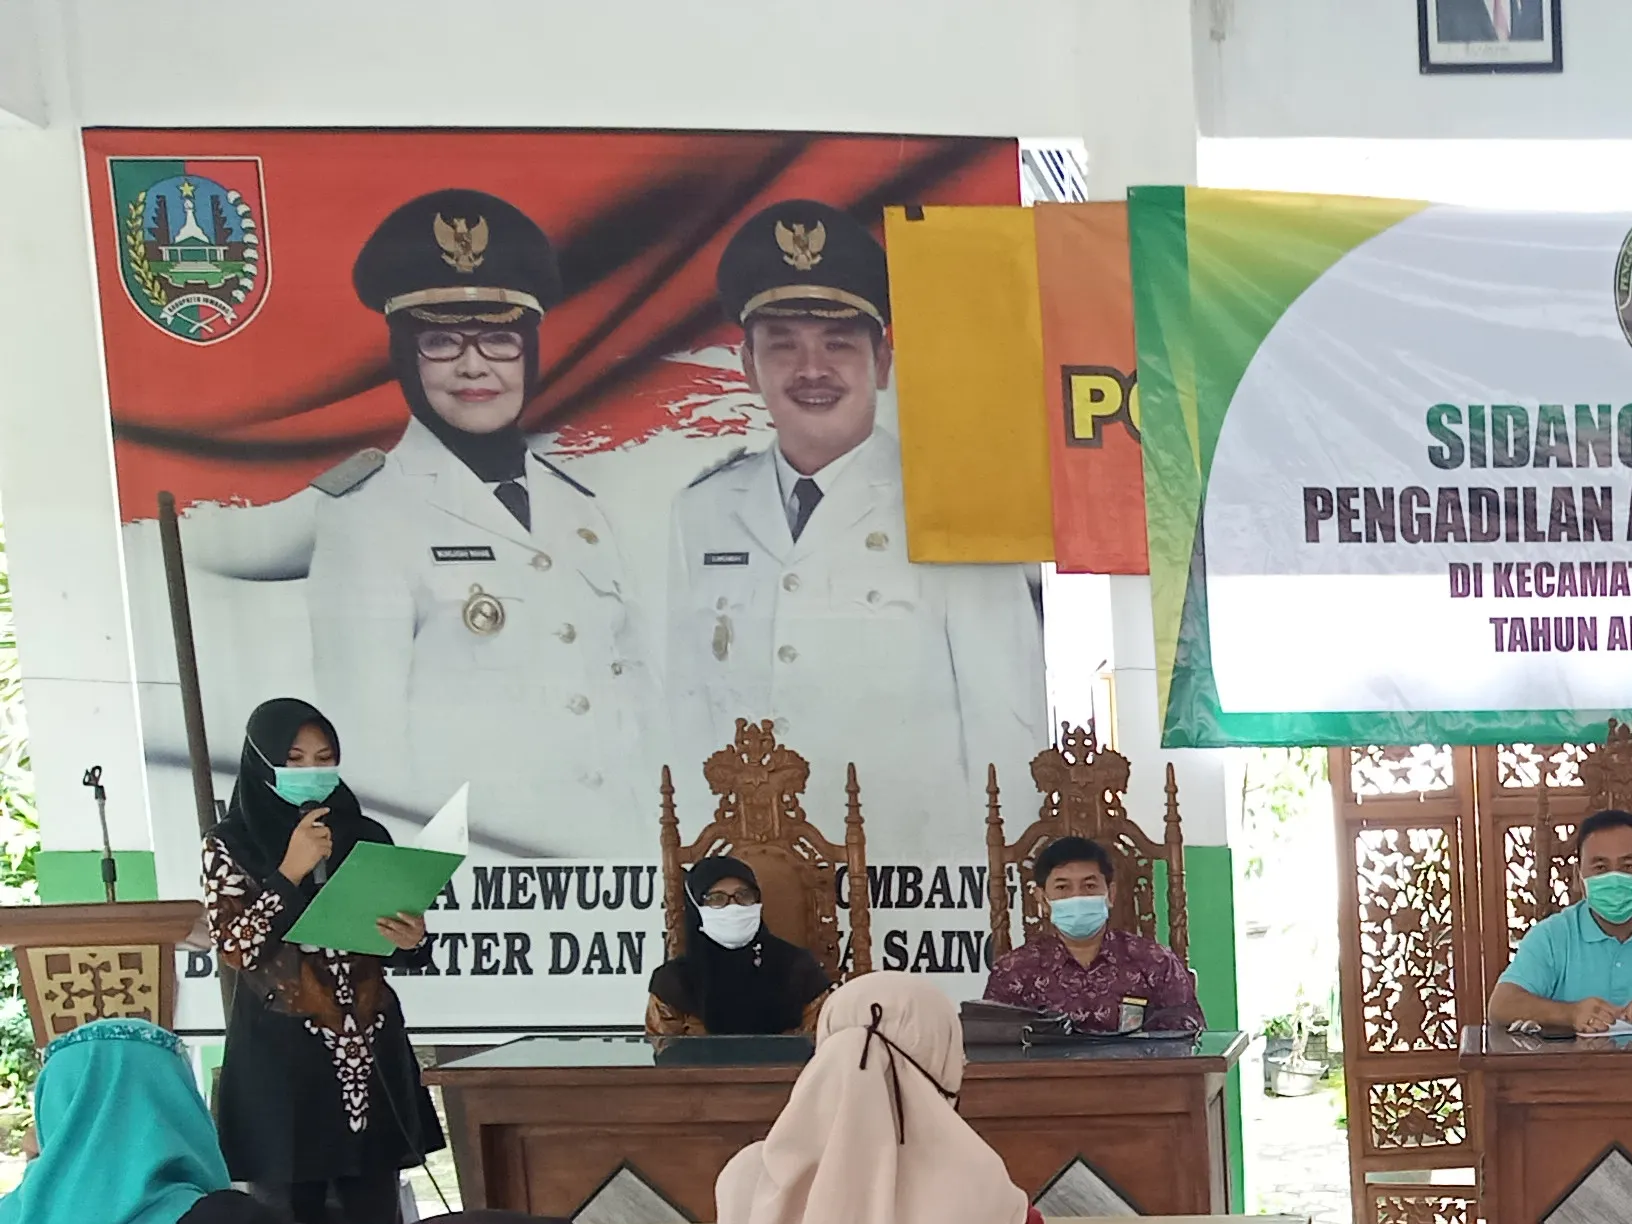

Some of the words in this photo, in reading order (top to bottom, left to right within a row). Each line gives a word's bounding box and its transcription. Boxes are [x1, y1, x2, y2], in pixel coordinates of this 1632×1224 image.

[1302, 485, 1614, 545] PENGADILAN
[1448, 562, 1483, 599] DI
[1489, 616, 1598, 653] TAHUN
[471, 866, 664, 911] MEWUJU
[548, 931, 646, 975] DAN
